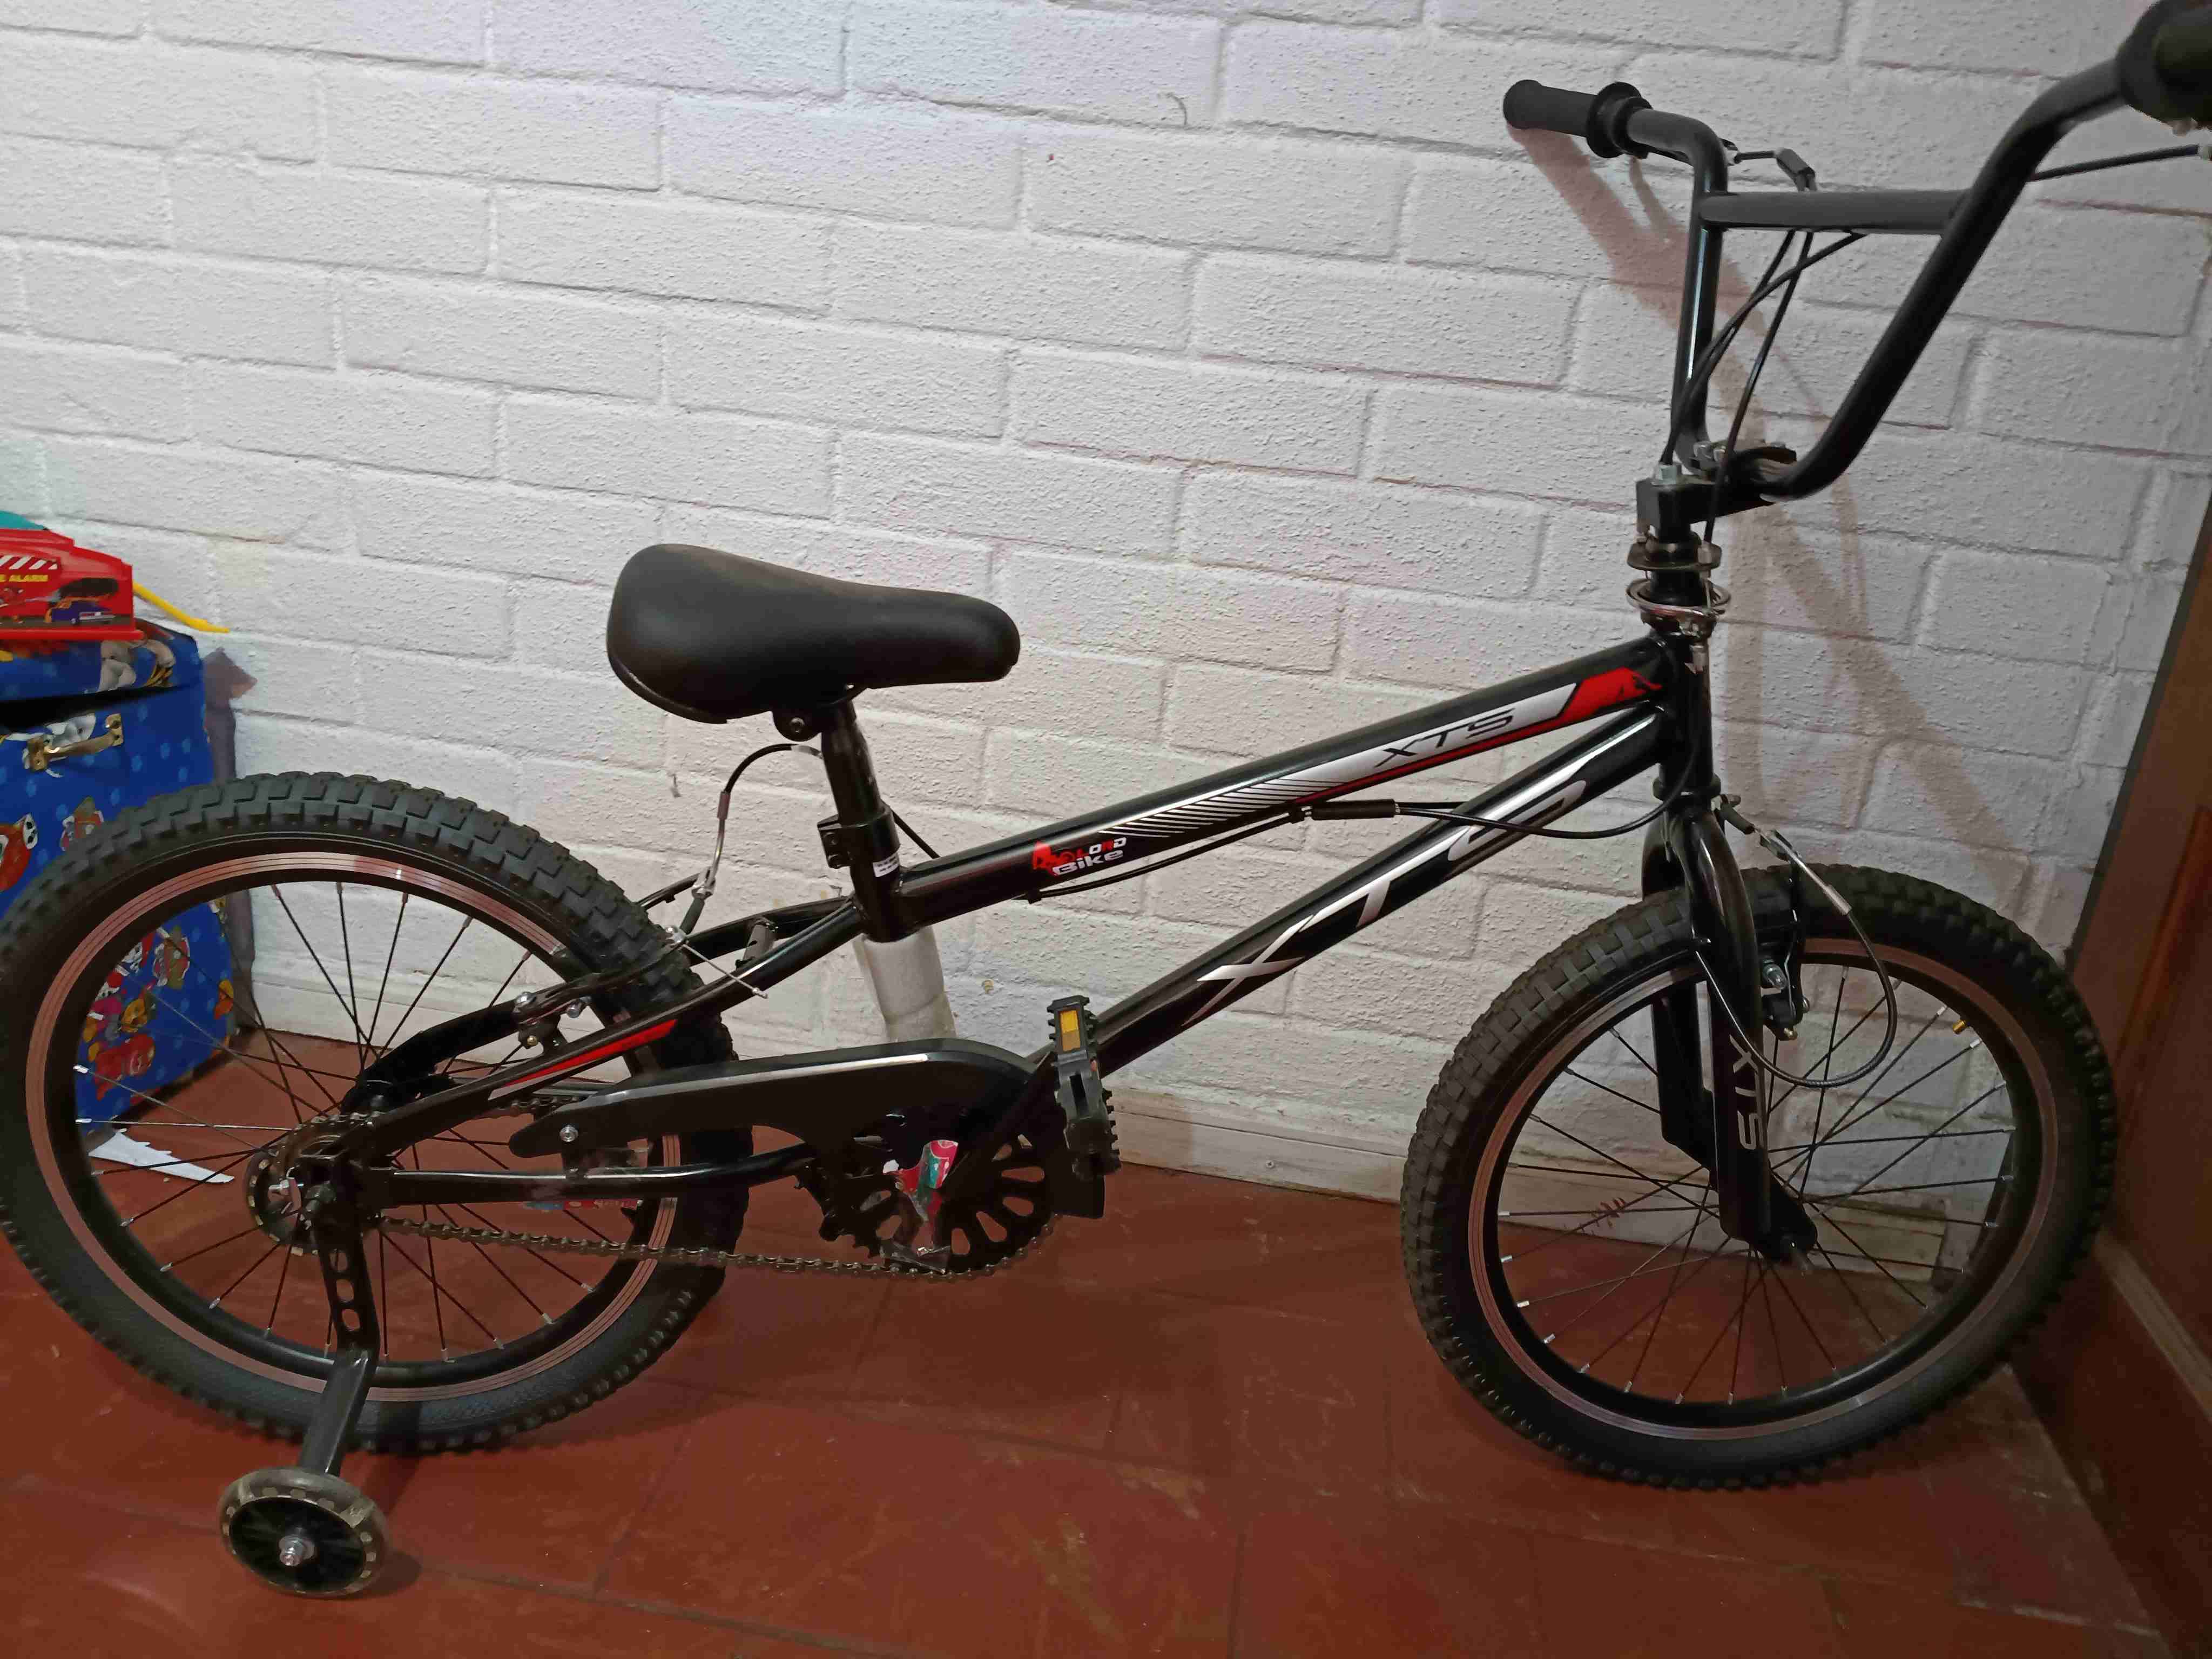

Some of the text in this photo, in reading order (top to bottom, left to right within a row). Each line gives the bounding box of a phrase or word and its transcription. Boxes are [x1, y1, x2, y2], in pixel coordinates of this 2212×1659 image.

[1374, 707, 1516, 768] XTS
[1053, 849, 1123, 876] Bike
[1182, 755, 1594, 1027] XTS
[1729, 1034, 1765, 1150] XTS
